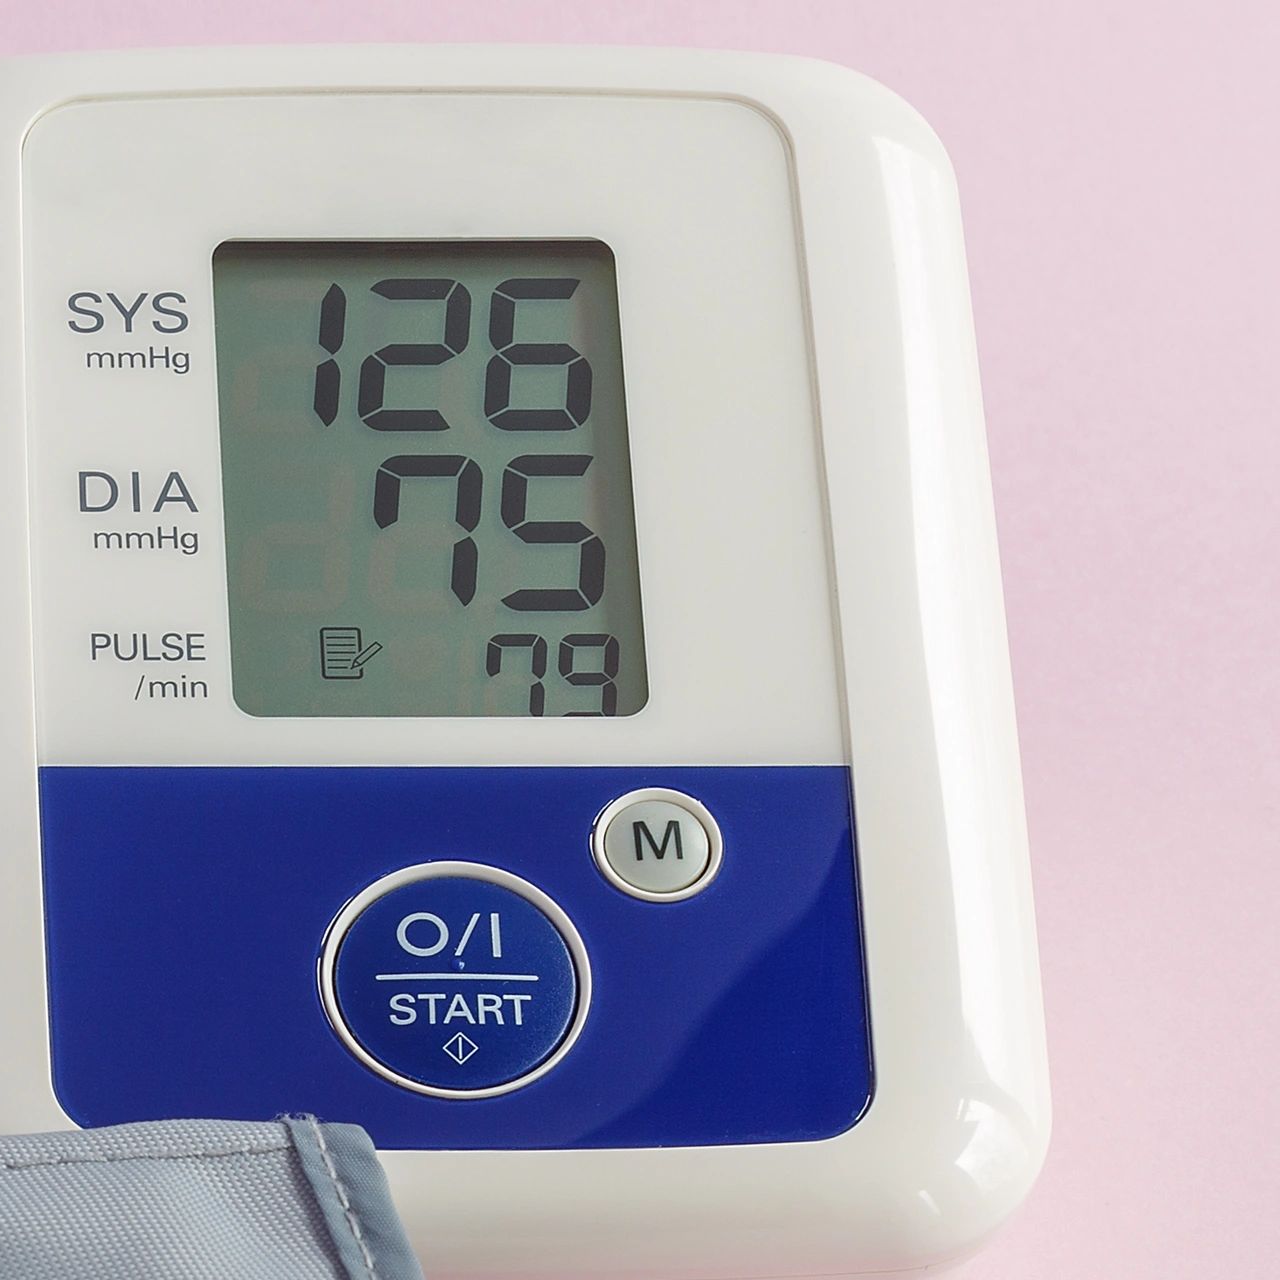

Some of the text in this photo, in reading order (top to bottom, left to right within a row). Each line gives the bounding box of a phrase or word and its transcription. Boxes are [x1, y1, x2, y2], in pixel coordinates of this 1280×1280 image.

[67, 291, 189, 334] SYS
[86, 346, 190, 375] mmHg
[314, 278, 593, 431] 126
[78, 471, 199, 513] DIA
[93, 526, 199, 556] mmHg
[373, 454, 606, 611] 75
[91, 632, 206, 662] PULSE
[134, 674, 208, 701] /min
[486, 633, 619, 717] 79
[632, 819, 684, 862] M
[389, 993, 532, 1026] START
